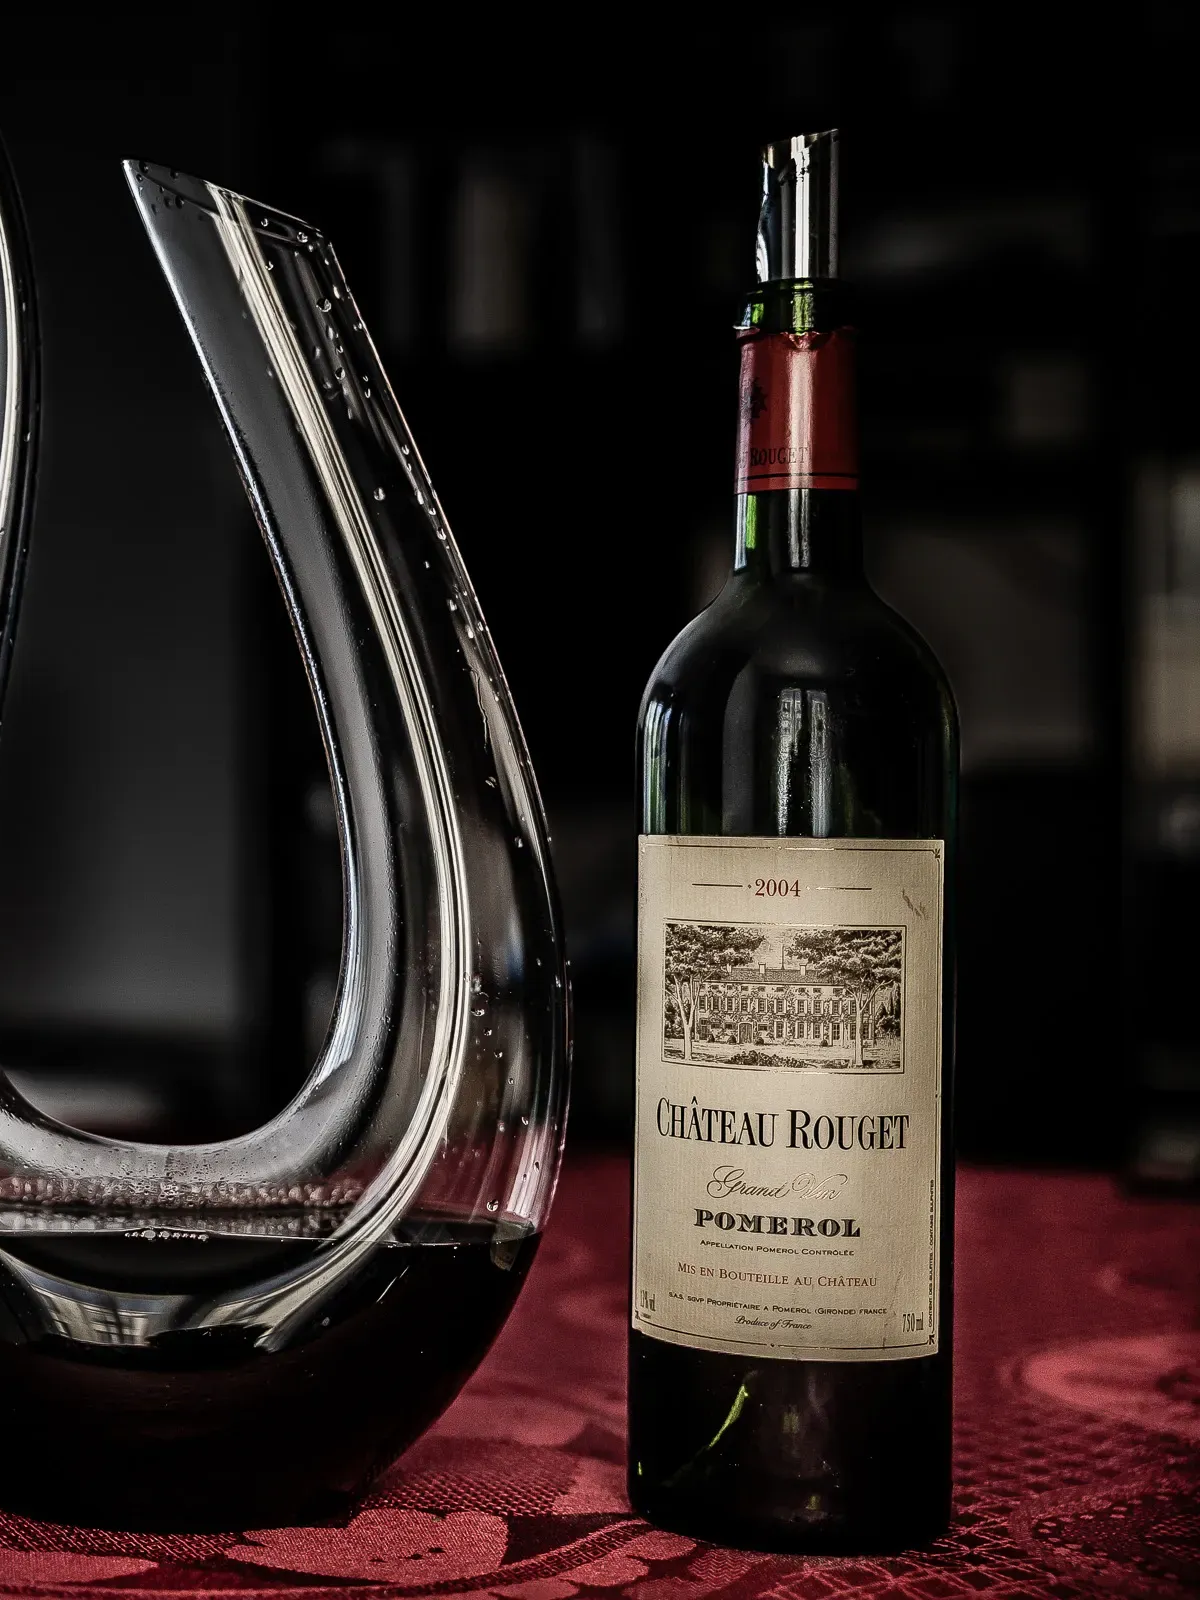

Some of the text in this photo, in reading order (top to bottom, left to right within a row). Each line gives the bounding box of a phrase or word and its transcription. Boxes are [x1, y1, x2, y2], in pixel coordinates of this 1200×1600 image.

[750, 447, 809, 467] ROUGET
[754, 878, 802, 897] 2004
[656, 1095, 910, 1151] CHÂTEAU ROUGET
[706, 1165, 848, 1201] Grand Vin
[693, 1208, 861, 1237] POMEROL
[700, 1239, 855, 1256] APPELLATION POMEROL CONTRÔLÉE
[677, 1261, 878, 1287] MIS EN BOUTEILLE AU CHÂTEAU
[706, 1297, 761, 1311] PROPRIÉTAIRE
[772, 1305, 812, 1314] POMEROL
[734, 1315, 813, 1331] Produce of France
[902, 1312, 915, 1333] 750
